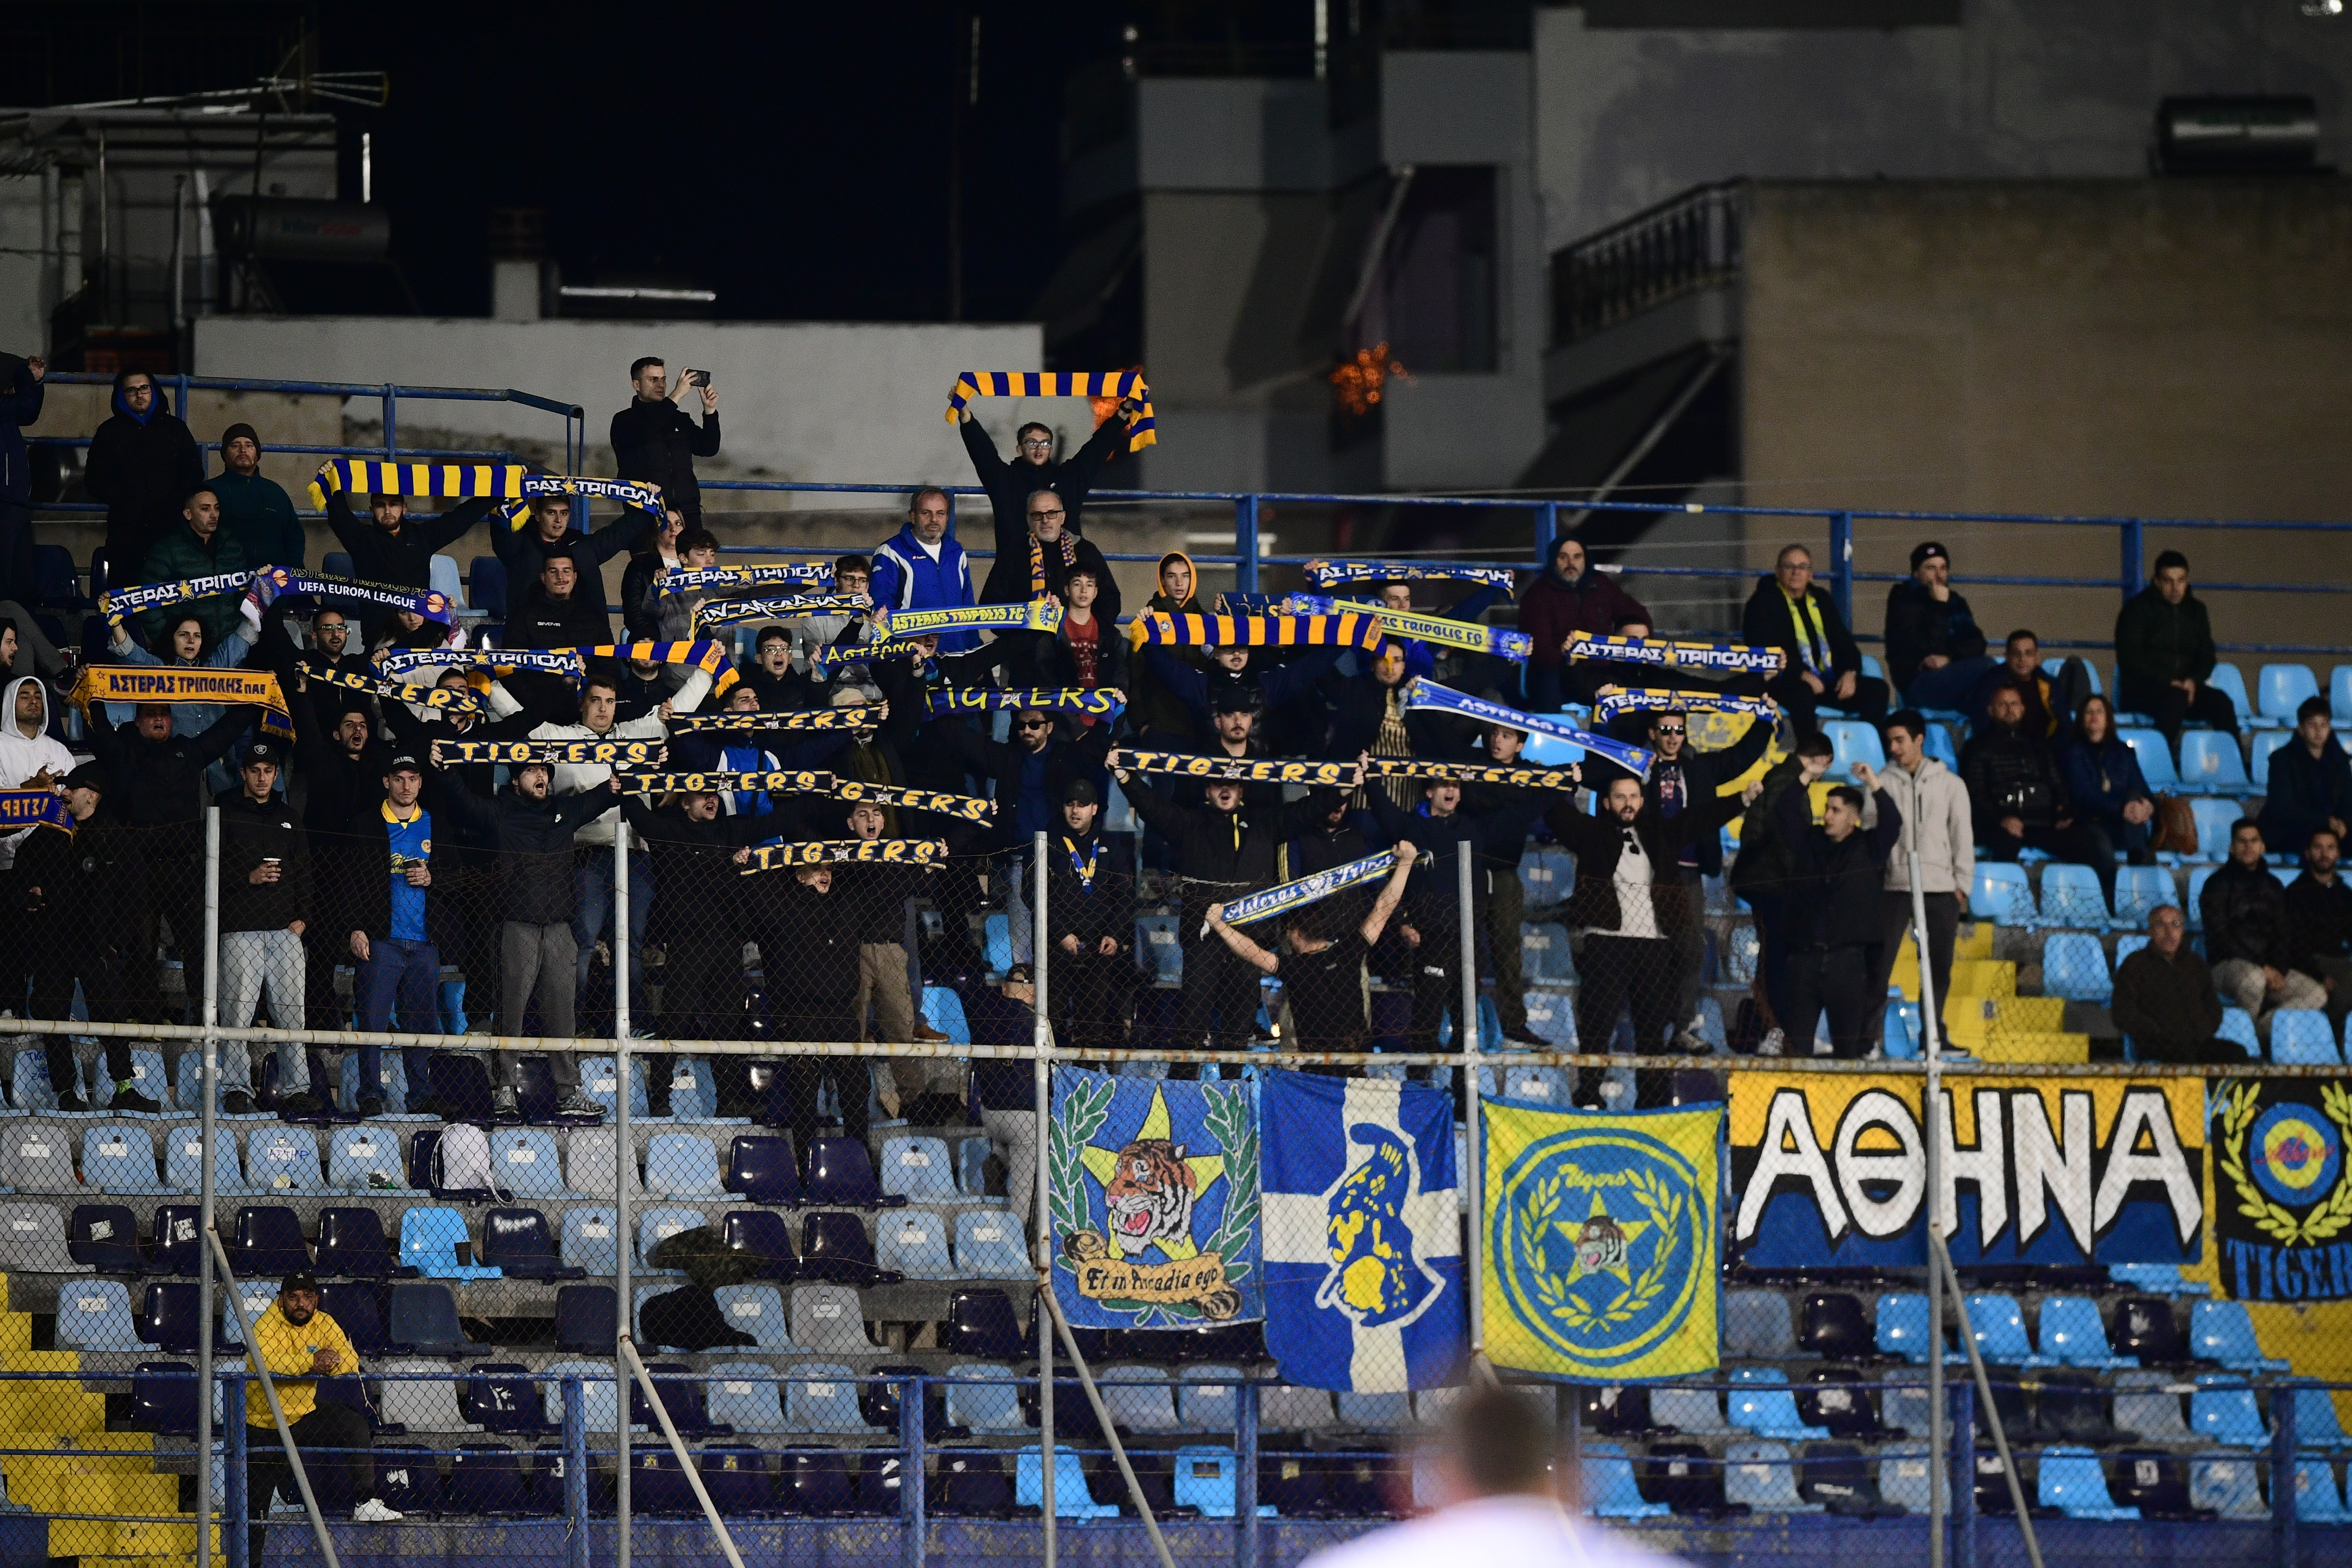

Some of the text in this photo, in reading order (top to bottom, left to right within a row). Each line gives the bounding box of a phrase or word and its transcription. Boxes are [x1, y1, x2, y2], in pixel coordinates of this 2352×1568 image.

[189, 571, 256, 592] ΤΡΙΠΟΛ
[410, 588, 427, 598] FC
[298, 581, 416, 610] UEFA EUROPA LEAGUE
[892, 607, 1026, 631] ASTERAS TRIPOLIS FC
[1402, 619, 1482, 644] TRIPOLIS FC
[381, 652, 475, 675] ΑΣΤΕΡΑΣ
[1571, 642, 1779, 668] ΑΣΤΕΡΑΣ ΤΡΙΠΟΛΗΣ
[109, 674, 175, 693] ΑΣΤΕΡΑΣ
[178, 676, 243, 694] ΤΡΙΠΟΛΗΣ
[325, 669, 478, 711] IGERS
[456, 742, 648, 762] TIGERS
[1132, 752, 1340, 784] TIGERS
[634, 771, 817, 792] TIGERS
[840, 781, 989, 820] GERS
[752, 839, 936, 871] TIGERS
[1735, 1087, 2203, 1256] ΑΘΗΝΑ
[1086, 1267, 1218, 1291] Et in Arcadia ego
[2226, 1237, 2352, 1300] TIGER
